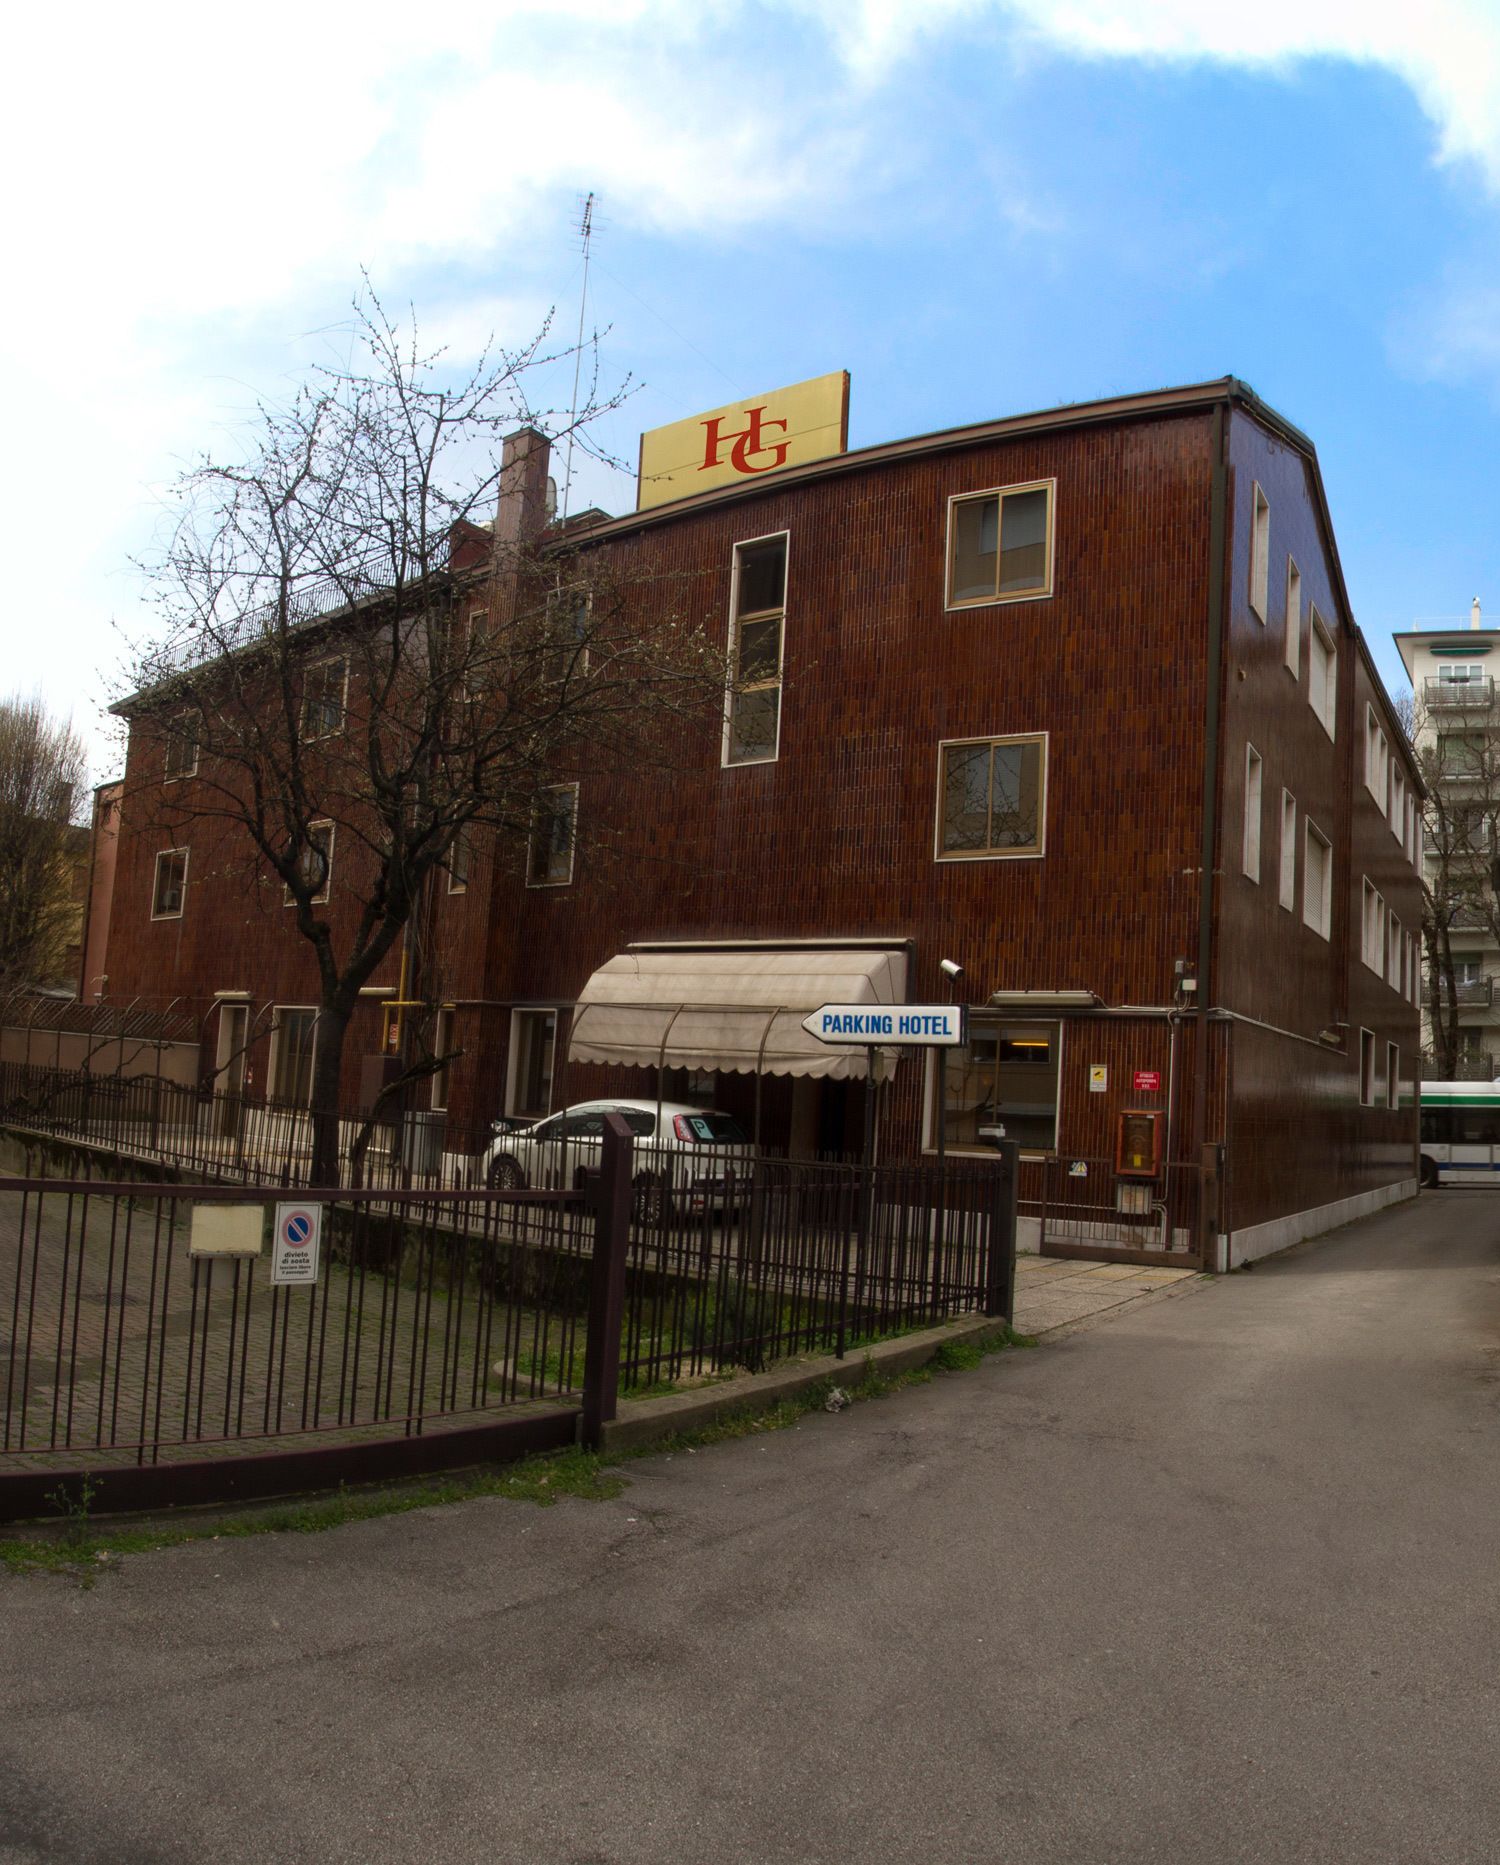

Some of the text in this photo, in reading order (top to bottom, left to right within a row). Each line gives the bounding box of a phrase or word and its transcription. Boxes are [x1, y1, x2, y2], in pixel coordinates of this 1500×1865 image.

[697, 405, 792, 474] HG
[822, 1014, 952, 1035] PARKING HOTEL
